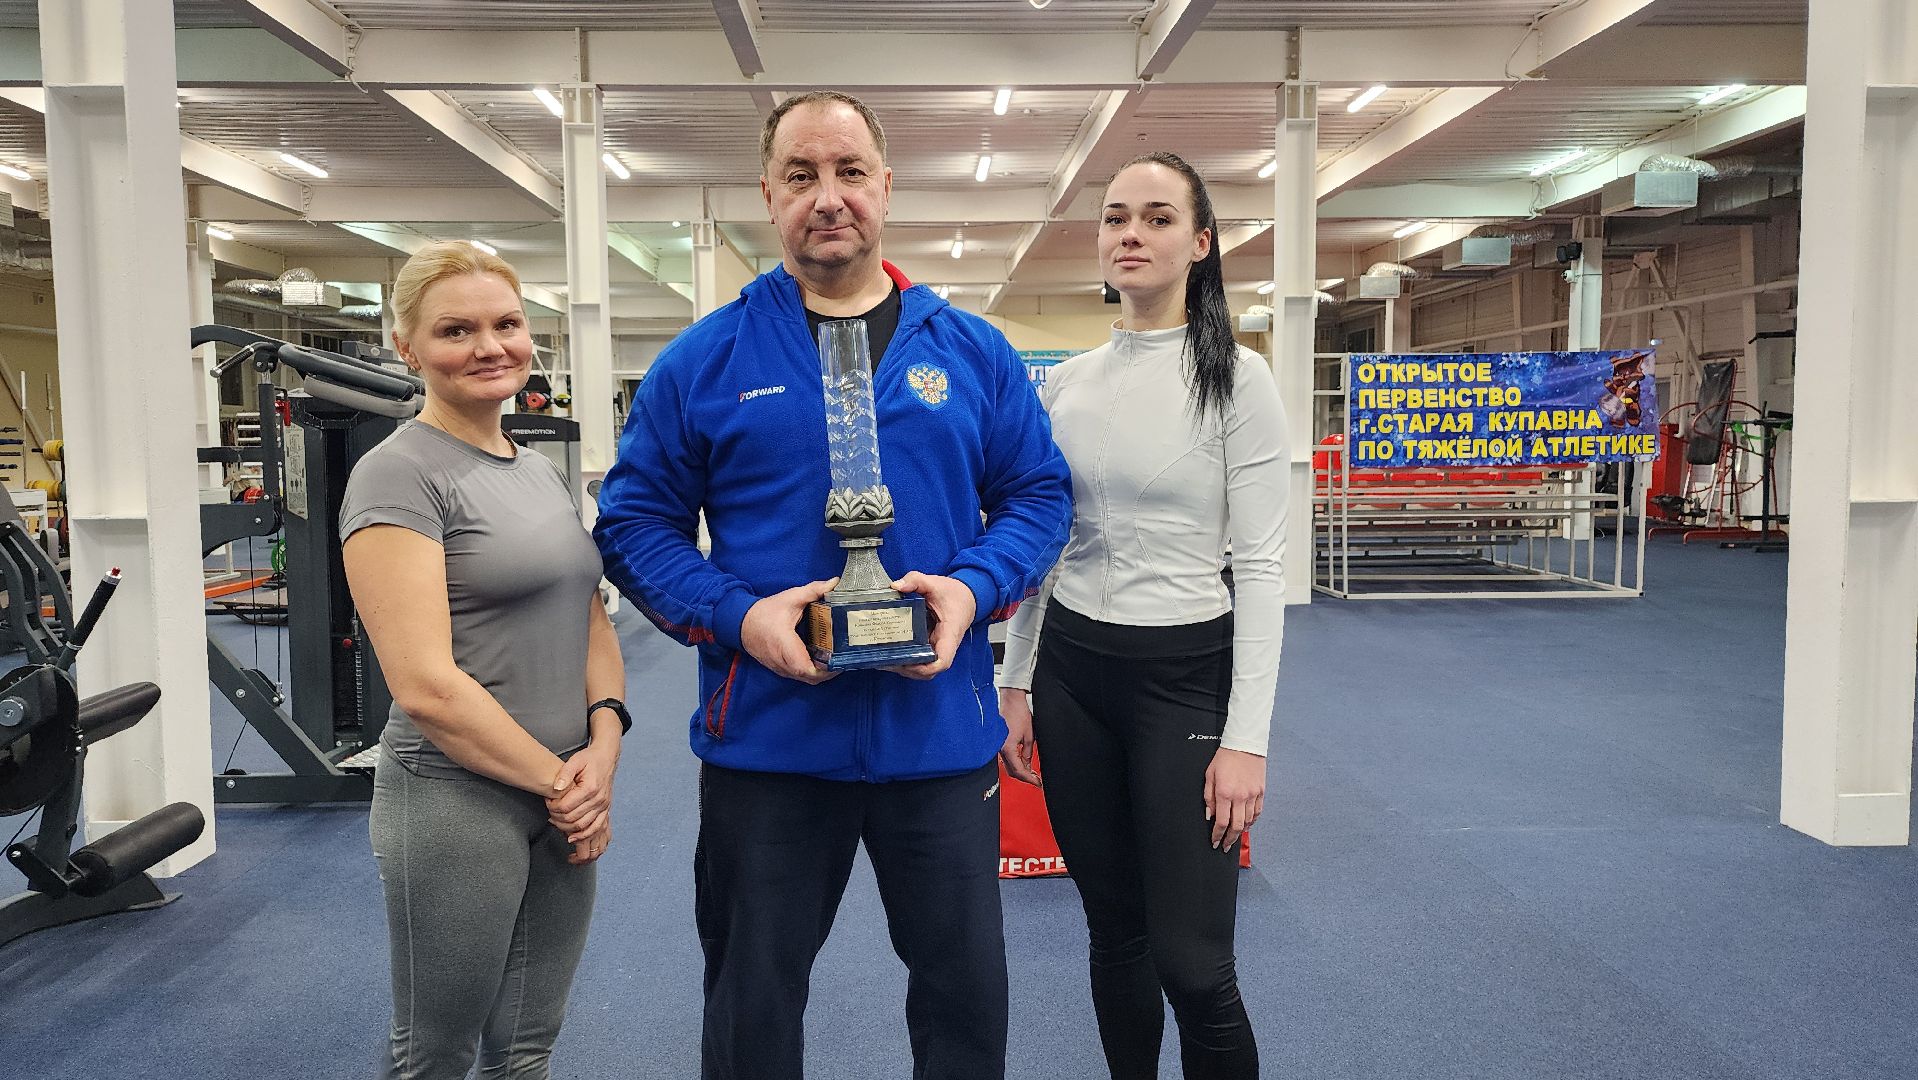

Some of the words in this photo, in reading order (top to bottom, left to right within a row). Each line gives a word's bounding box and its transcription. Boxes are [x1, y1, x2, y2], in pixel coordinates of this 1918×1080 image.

[1358, 362, 1492, 383] ОТКРЫТОЕ
[738, 385, 786, 403] FORWARD
[1358, 387, 1522, 409] ПЕРВЕНСТВО
[1359, 412, 1473, 434] г.СТАРАЯ
[1488, 409, 1603, 432] КУПАВНА
[1358, 440, 1394, 460] ПО
[1403, 434, 1523, 460] ТЯЖЁЛОЙ
[1530, 434, 1656, 458] АТЛЕТИКЕ
